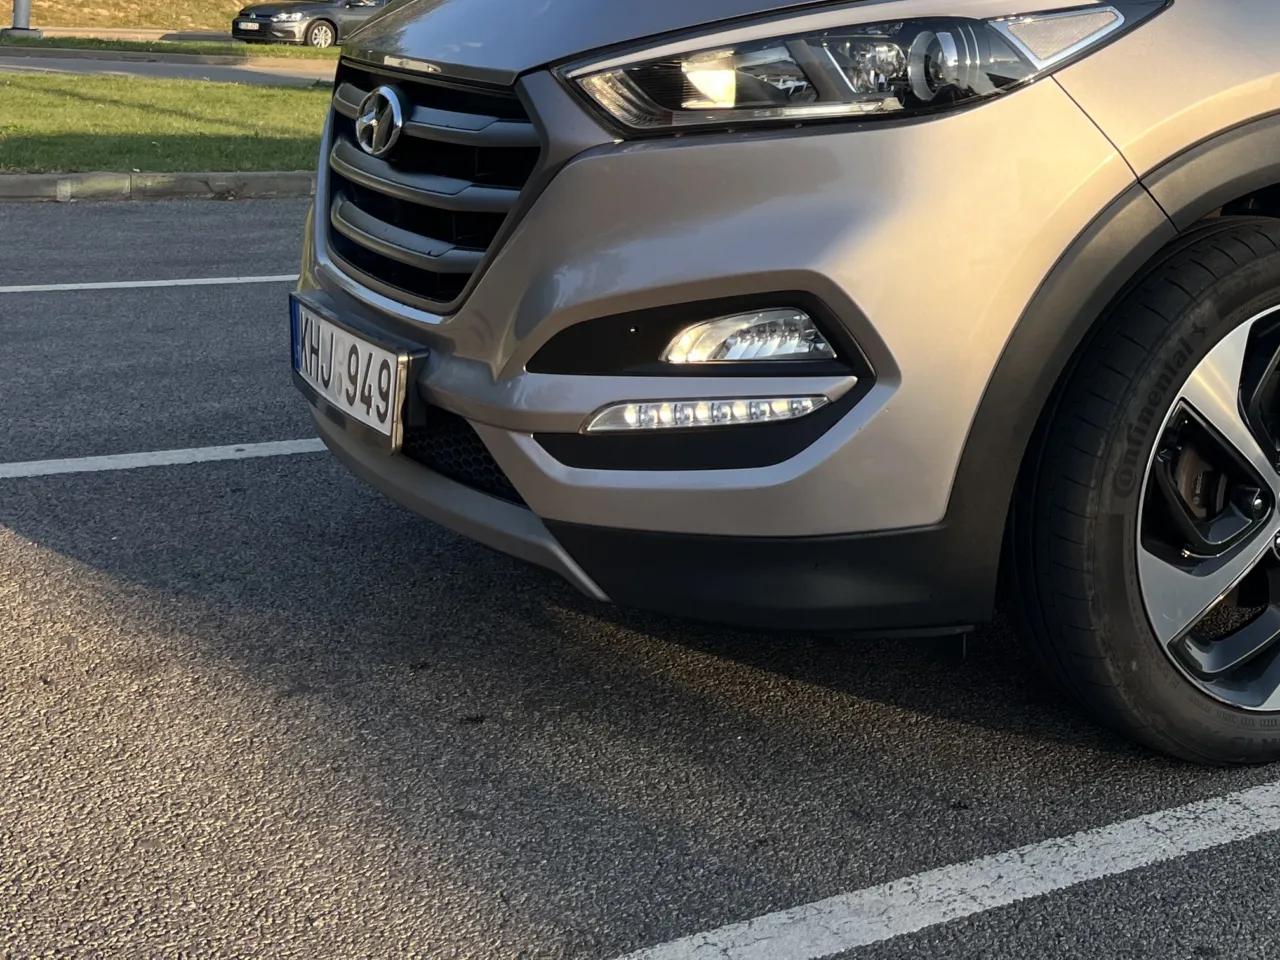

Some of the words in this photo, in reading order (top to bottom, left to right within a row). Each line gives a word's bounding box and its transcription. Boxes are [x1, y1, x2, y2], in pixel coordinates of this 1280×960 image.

[301, 311, 336, 389] KHJ
[346, 343, 392, 424] 949
[1112, 335, 1195, 499] Continental
